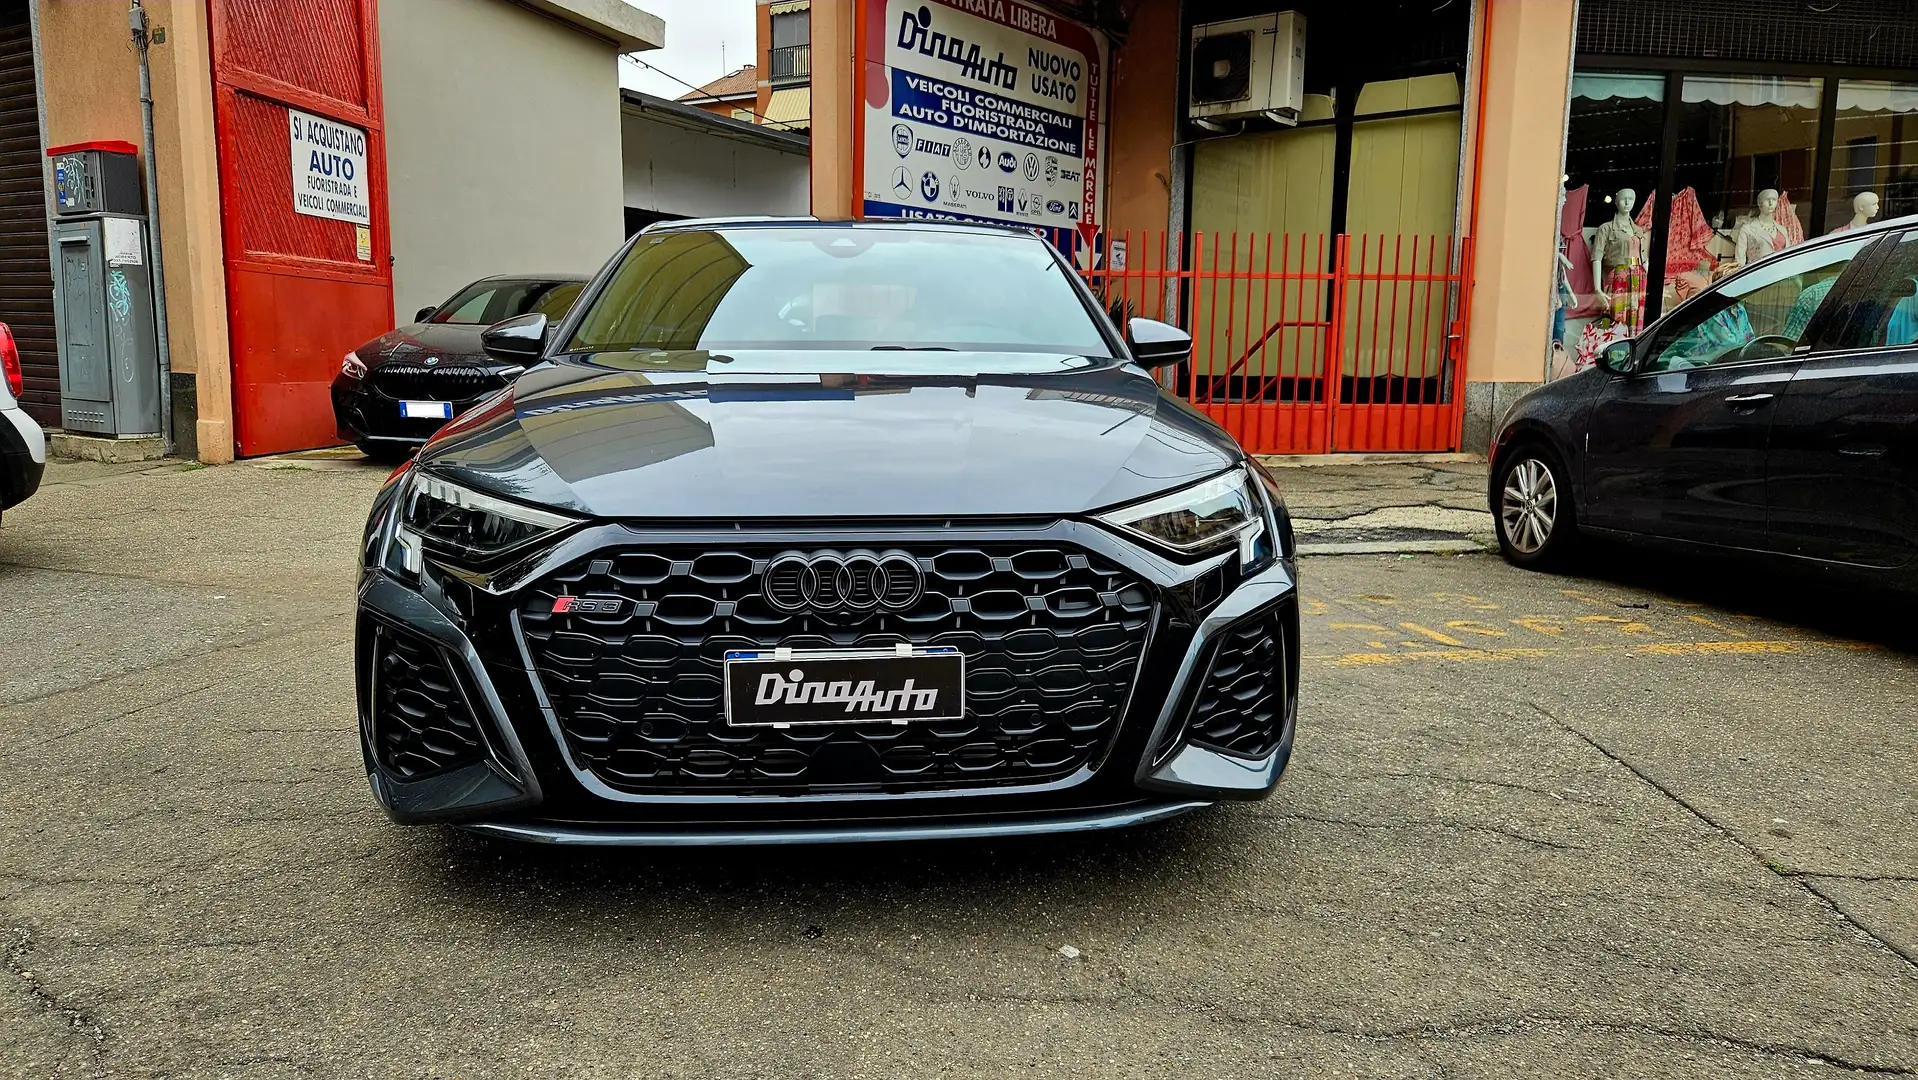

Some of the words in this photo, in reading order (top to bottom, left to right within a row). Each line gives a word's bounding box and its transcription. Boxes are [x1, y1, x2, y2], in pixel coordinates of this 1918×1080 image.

[1010, 5, 1057, 40] LIBERA
[1028, 47, 1081, 82] NUOVO
[906, 76, 970, 103] VEICOLI
[974, 94, 1072, 129] COMMERCIALI
[1031, 73, 1077, 104] USATO
[1089, 63, 1099, 121] TUTTE
[899, 103, 948, 124] AUTO
[953, 116, 1077, 154] D'IMPORTAZIONE
[941, 99, 1046, 135] FUORISTRADA
[293, 115, 303, 141] SI
[307, 120, 364, 157] ACQUISTANO
[916, 139, 951, 157] FIAT
[1089, 128, 1096, 151] LE
[309, 150, 355, 181] AUTO
[998, 154, 1017, 169] Audi
[307, 175, 352, 197] FUORISTRADA
[353, 185, 358, 199] E
[965, 189, 995, 201] VOLVO
[1084, 157, 1097, 225] MARCHE
[297, 192, 324, 211] VEICOLI
[326, 199, 368, 219] COMMERCIALI
[562, 600, 598, 612] RS
